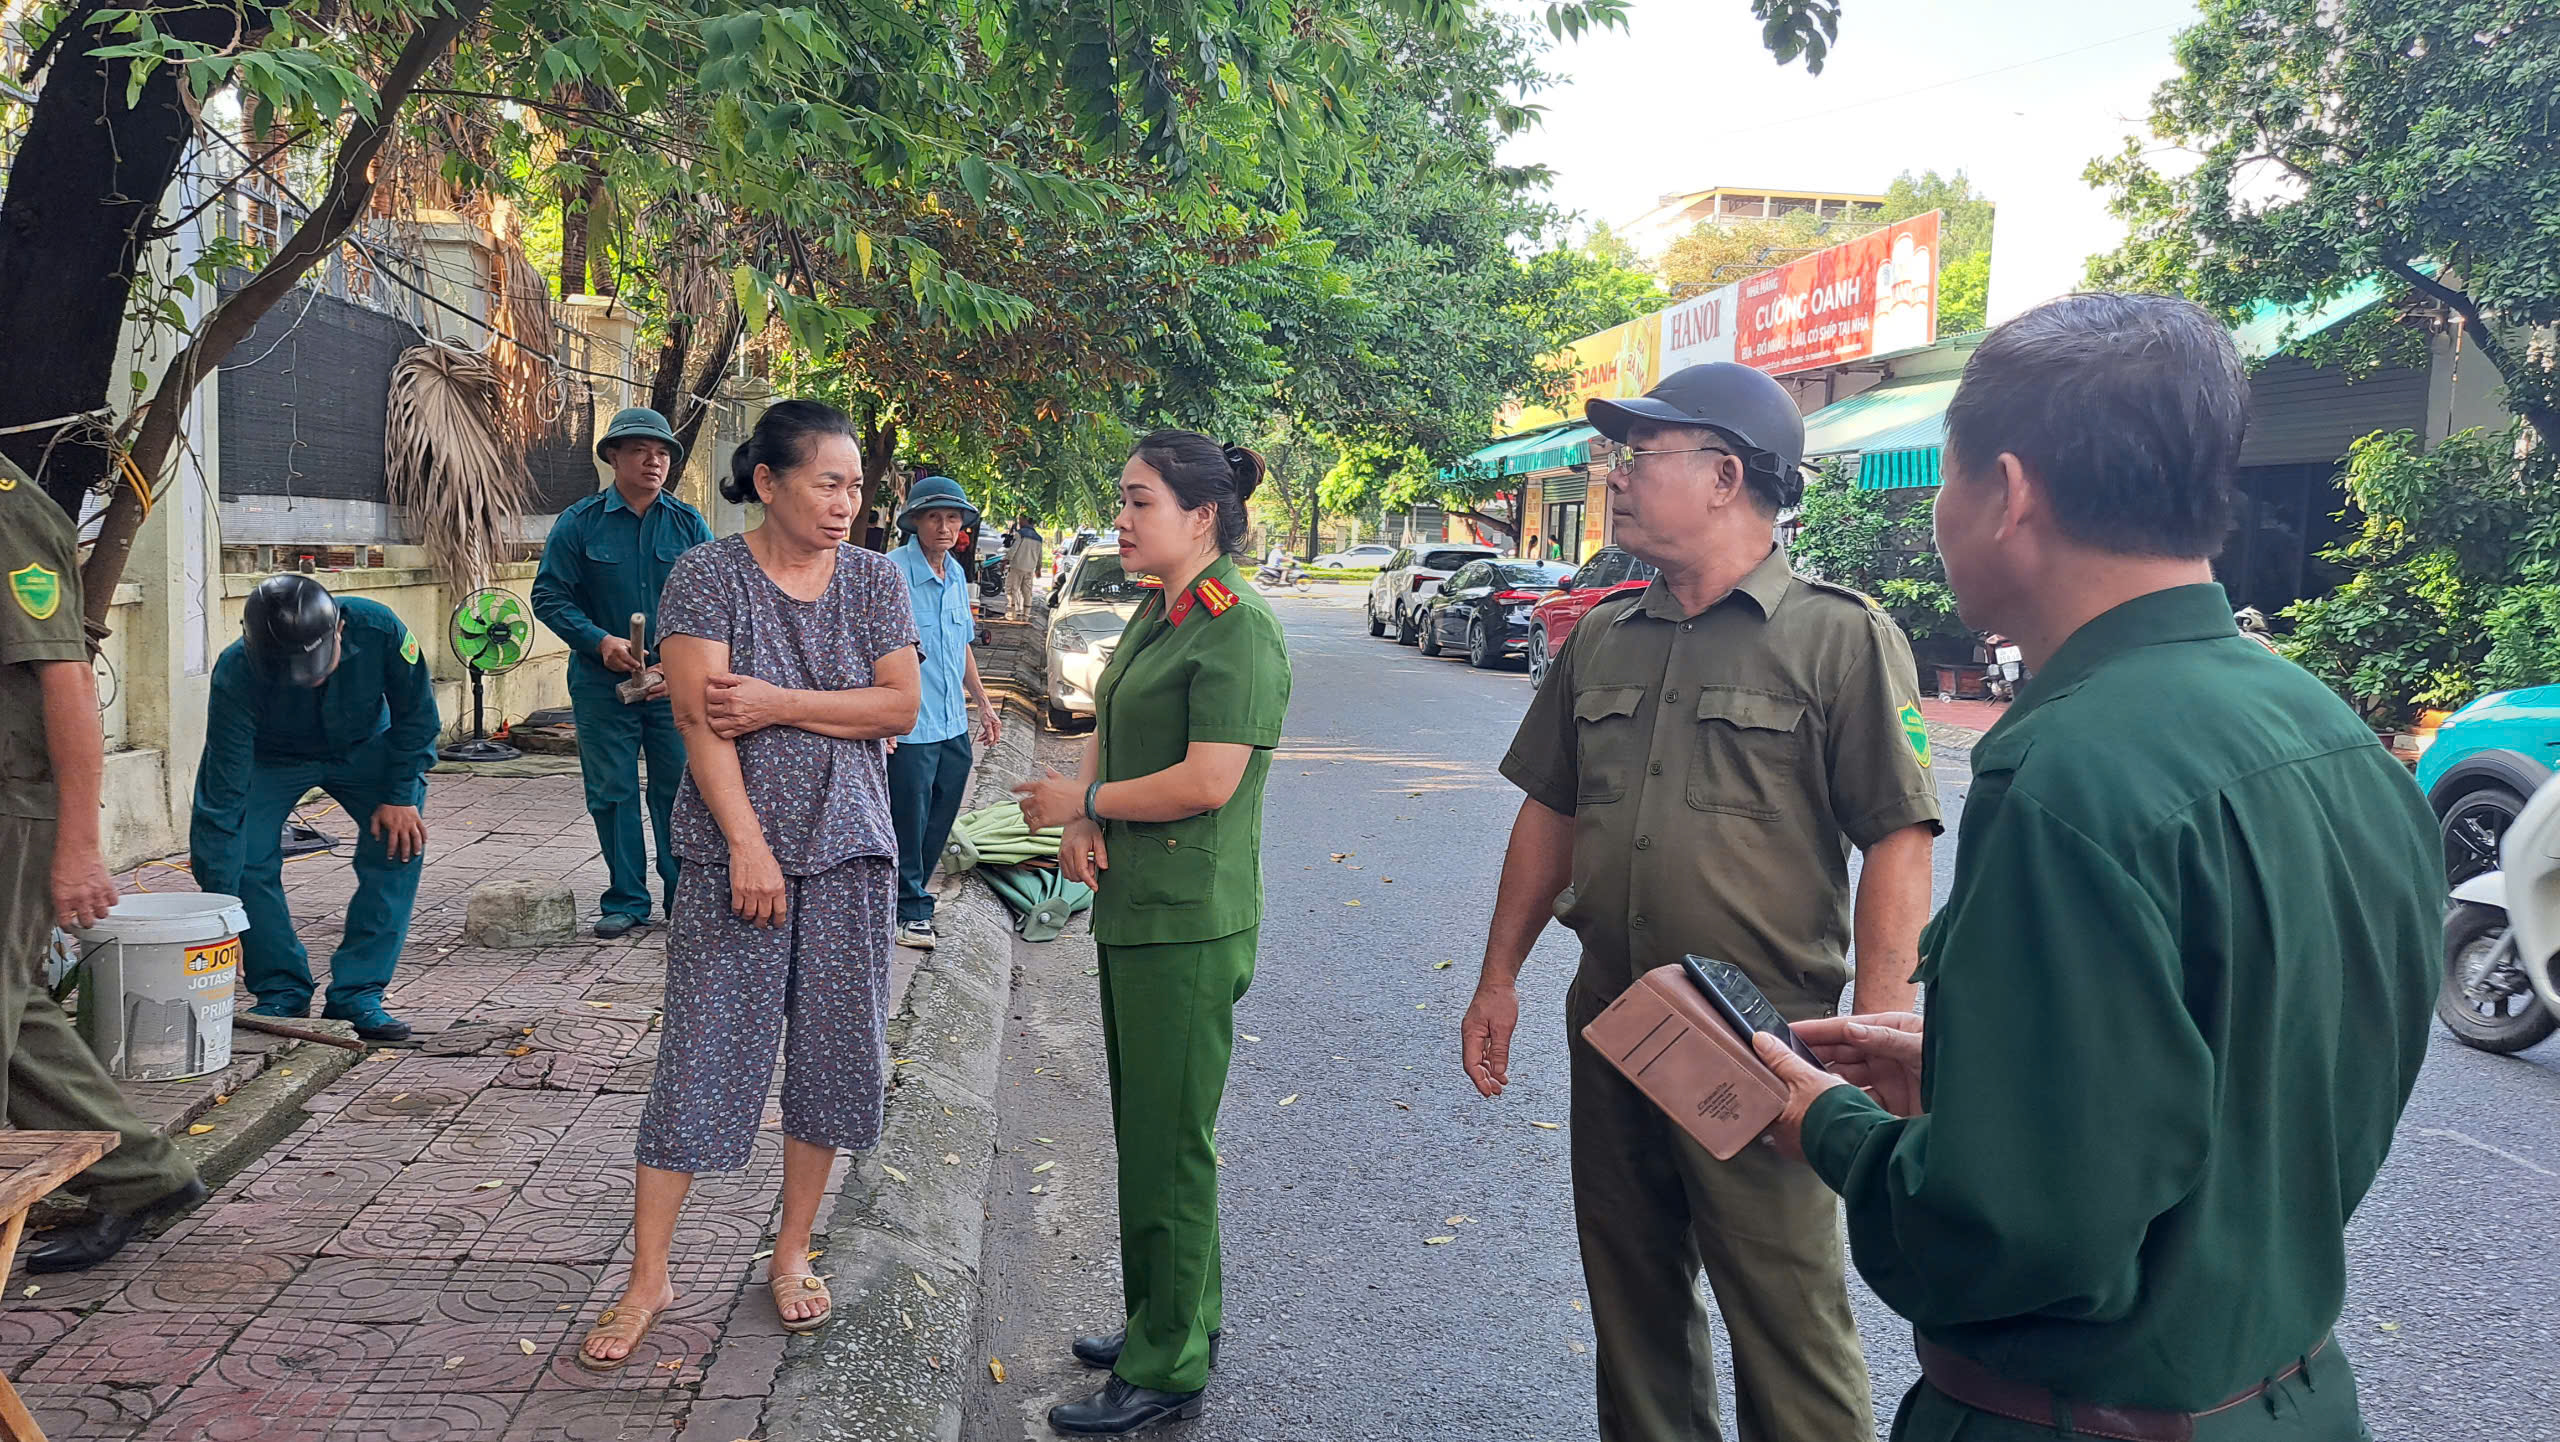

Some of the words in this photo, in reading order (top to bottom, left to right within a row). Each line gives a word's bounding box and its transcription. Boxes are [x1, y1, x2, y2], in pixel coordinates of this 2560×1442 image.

[1671, 299, 1720, 350] HANOI
[1755, 292, 1808, 331] CƯỜNG
[1811, 276, 1861, 315] OANH
